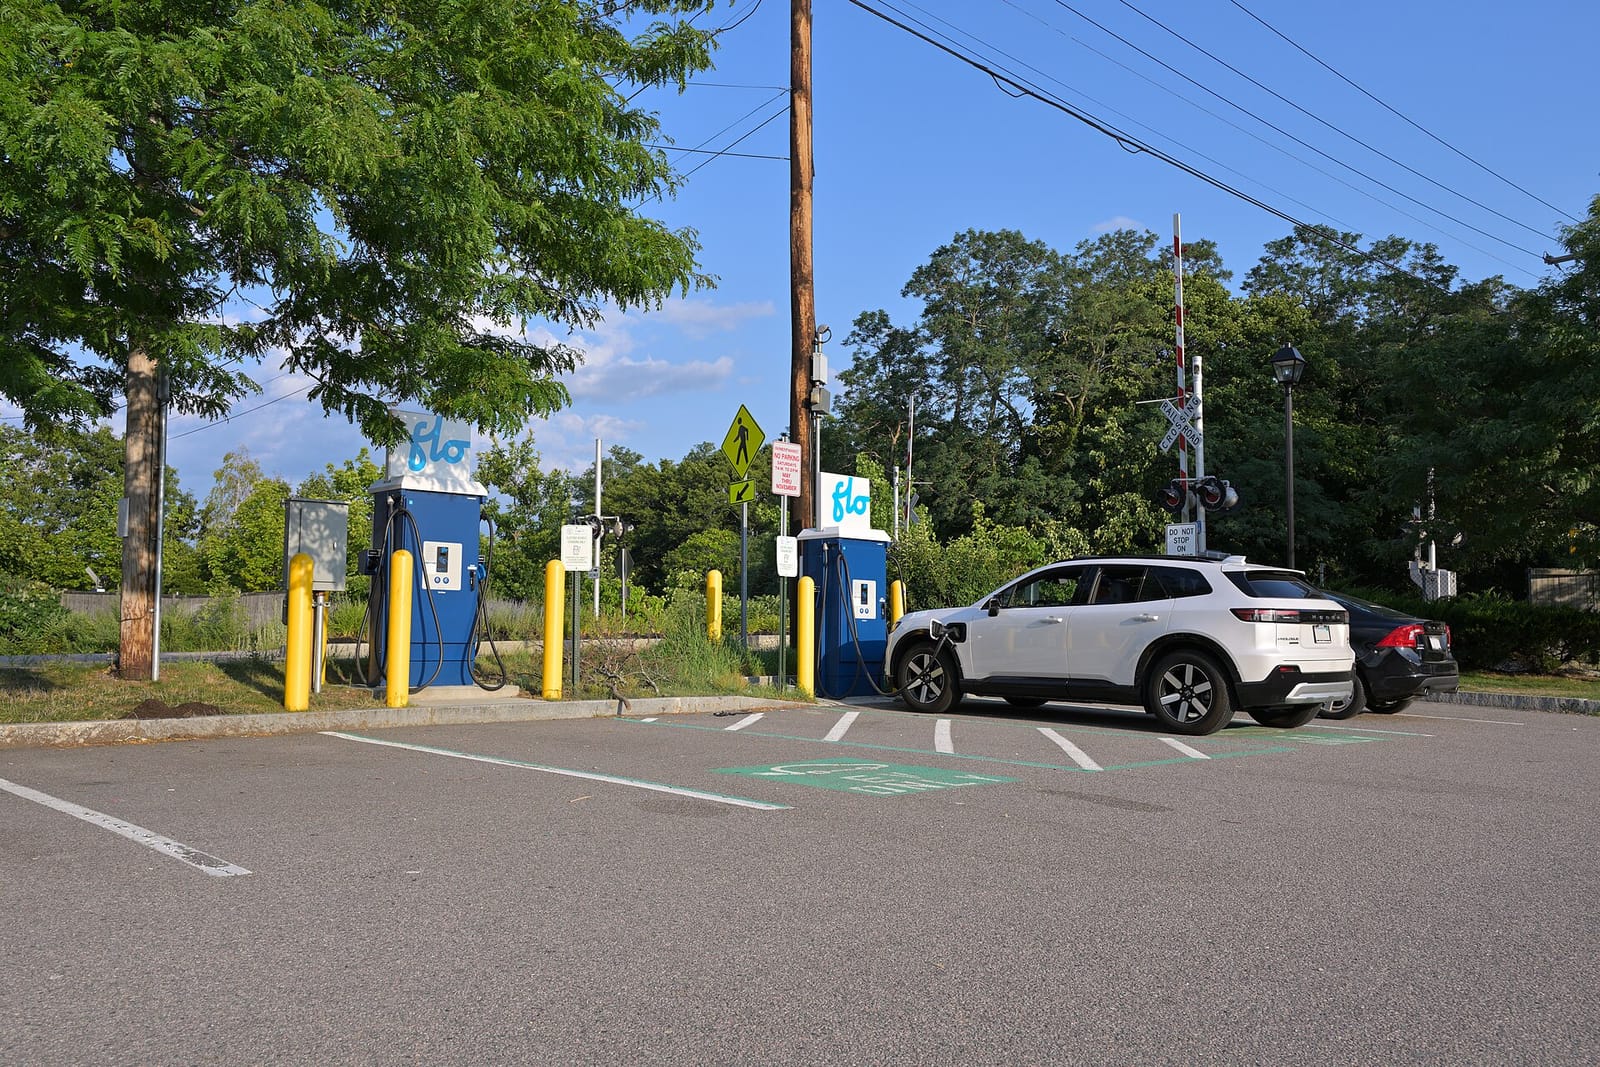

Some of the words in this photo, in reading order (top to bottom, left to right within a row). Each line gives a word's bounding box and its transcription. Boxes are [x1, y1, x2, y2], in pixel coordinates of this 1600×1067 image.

[1162, 397, 1199, 449] CROSSING
[1162, 402, 1178, 423] RAIL
[1181, 425, 1200, 446] ROAD
[407, 415, 471, 473] flo
[774, 452, 781, 460] NO
[781, 453, 800, 462] PARKING
[832, 475, 871, 523] flo
[1169, 528, 1178, 536] DO
[1181, 527, 1194, 535] NOT
[1173, 536, 1190, 544] STOP
[847, 774, 1003, 794] ONLY
